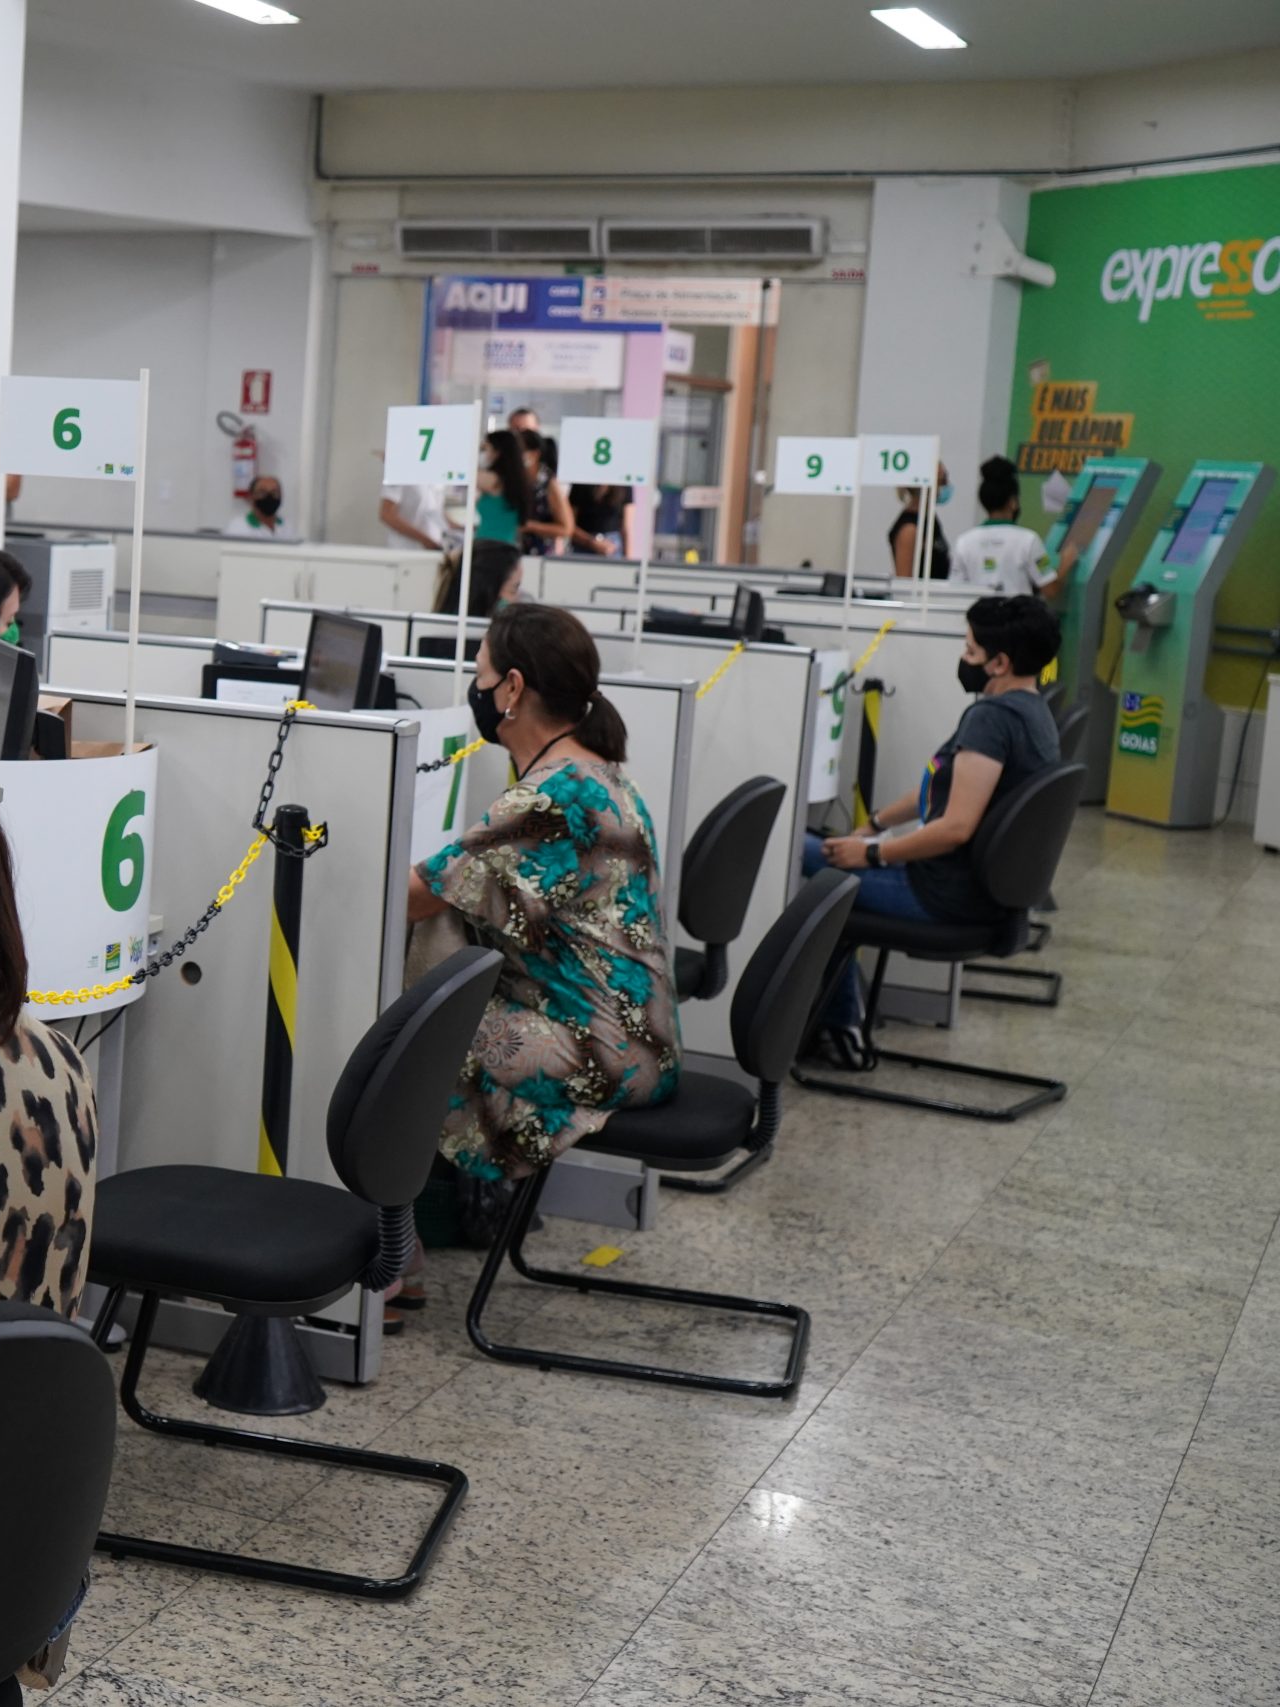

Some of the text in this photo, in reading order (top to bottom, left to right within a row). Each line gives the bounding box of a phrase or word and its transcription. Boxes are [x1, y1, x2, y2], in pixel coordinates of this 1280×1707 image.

[444, 282, 528, 313] AQUI
[1101, 236, 1280, 322] expresso
[53, 408, 81, 450] 6
[419, 429, 435, 461] 7
[593, 438, 612, 465] 8
[806, 454, 824, 479] 9
[880, 449, 910, 472] 10
[830, 671, 847, 740] 9
[442, 734, 467, 831] 7
[101, 790, 145, 912] 6
